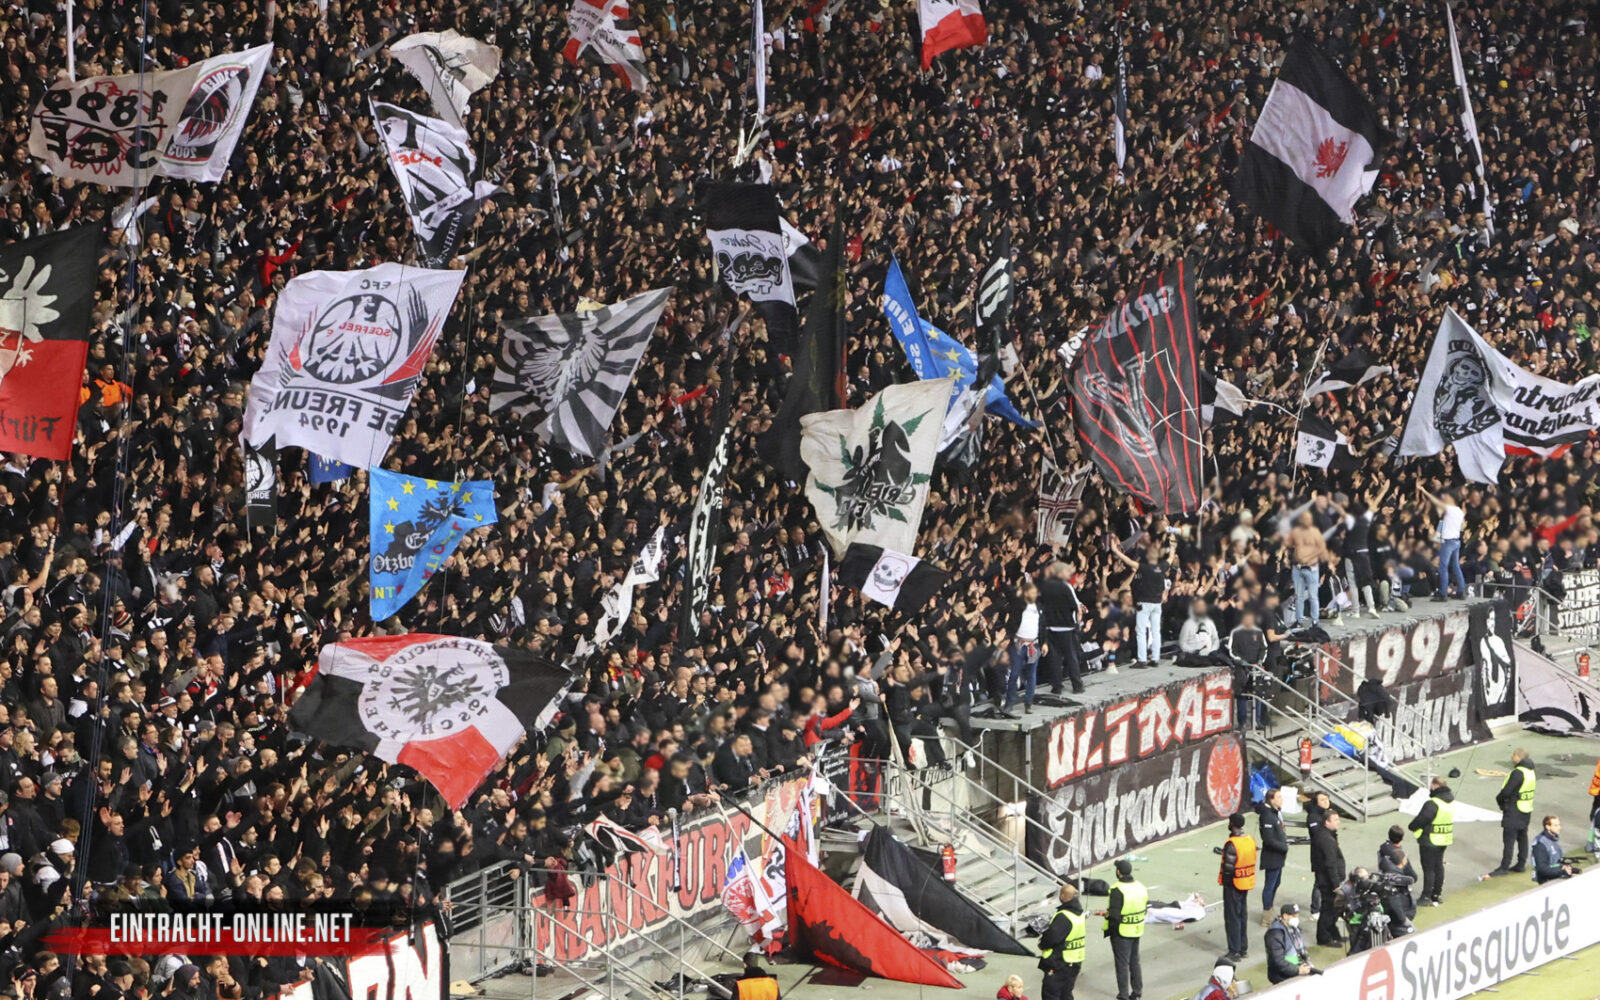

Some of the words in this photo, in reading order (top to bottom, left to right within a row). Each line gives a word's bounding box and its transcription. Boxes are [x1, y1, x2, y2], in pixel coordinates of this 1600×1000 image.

[1348, 611, 1471, 697] 1997
[1046, 670, 1233, 789] ULTRAS
[1046, 749, 1201, 876] Eintracht
[1401, 896, 1571, 1000] Swissquote
